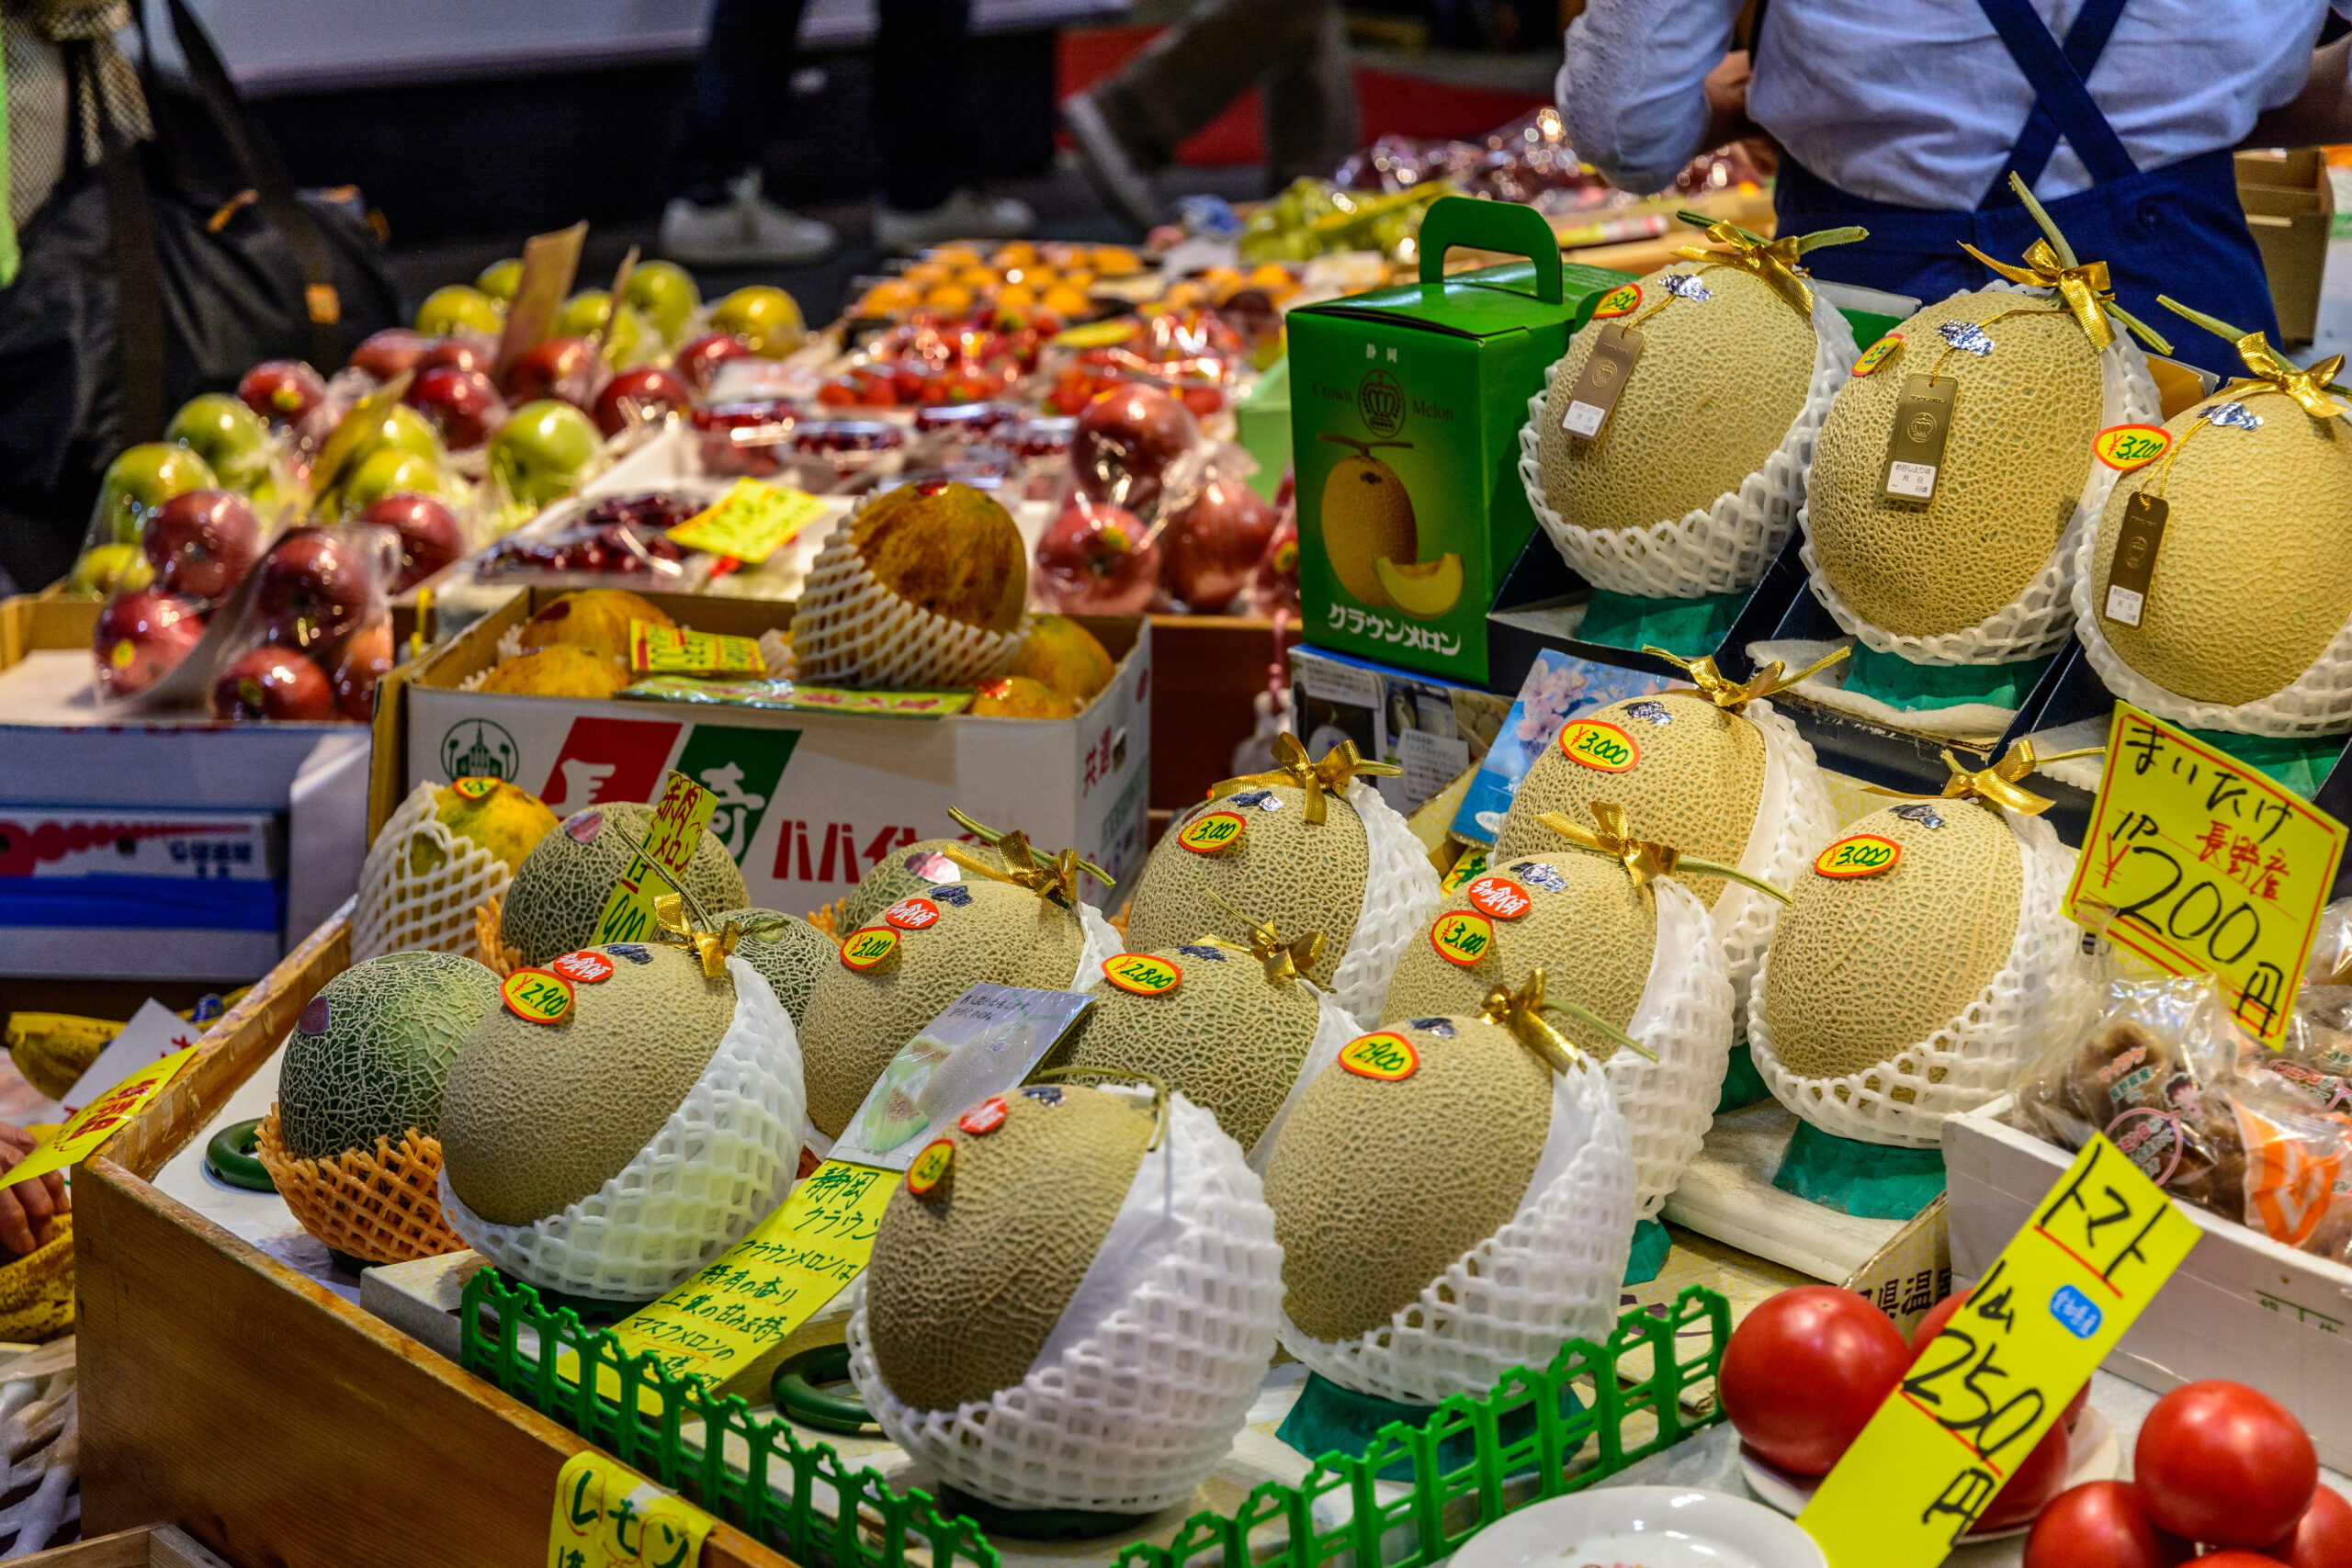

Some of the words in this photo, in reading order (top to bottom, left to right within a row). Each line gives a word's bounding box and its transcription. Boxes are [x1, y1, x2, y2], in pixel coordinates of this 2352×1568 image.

[1312, 380, 1353, 402] Crown
[1412, 398, 1453, 422] Melon
[1894, 464, 1931, 475] お召し上りは
[1329, 603, 1461, 656] クラウンメロン
[2126, 725, 2293, 844] まいたけ
[2196, 819, 2290, 901] 長野産
[2040, 1142, 2168, 1282] トマト
[733, 1238, 859, 1281] クラウンメロンは
[633, 1316, 735, 1361] マスクメロンの
[1902, 1327, 2044, 1462] 250
[1921, 1467, 1996, 1551] 円
